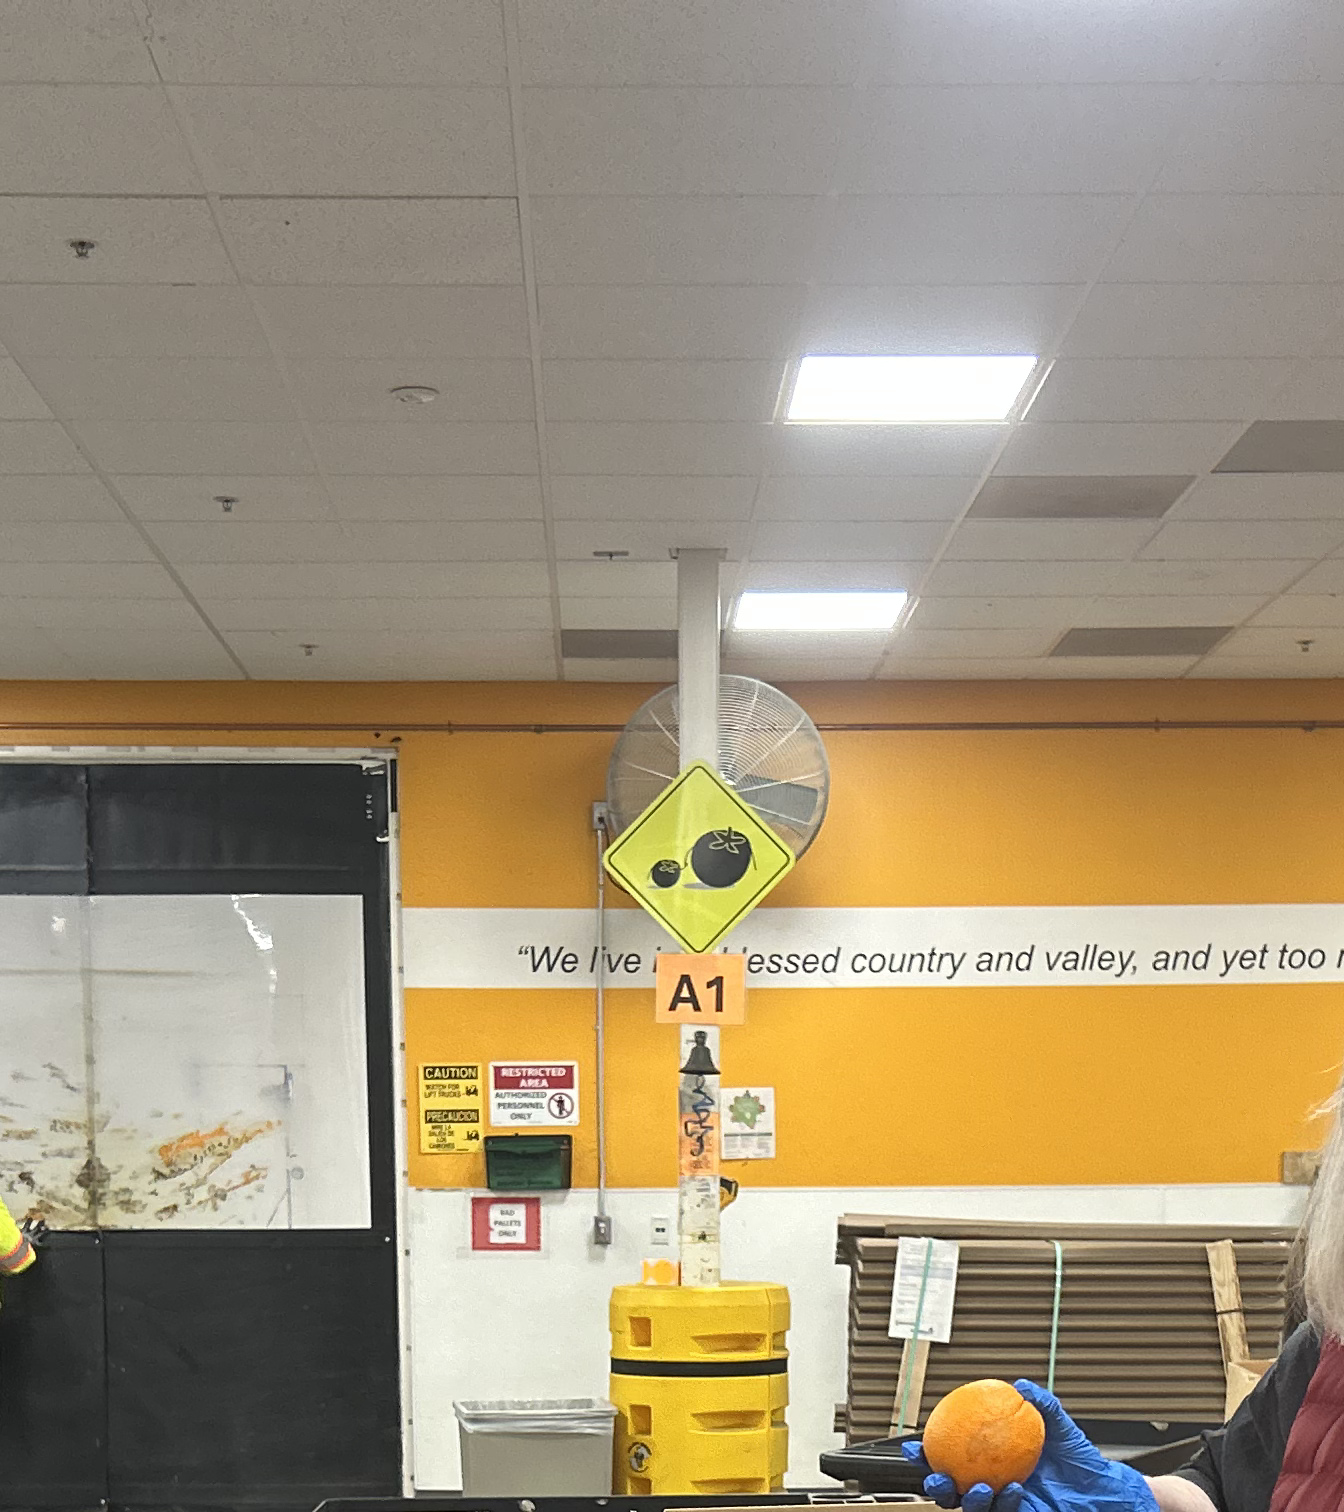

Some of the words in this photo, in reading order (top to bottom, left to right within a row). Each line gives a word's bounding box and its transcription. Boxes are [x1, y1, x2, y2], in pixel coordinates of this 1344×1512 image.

[851, 947, 967, 980] country
[976, 944, 1035, 972] and
[1045, 943, 1137, 978] valley,
[1152, 943, 1212, 971] and
[1219, 943, 1269, 978] yet
[1278, 943, 1326, 970] too
[668, 974, 724, 1013] A1
[425, 1067, 477, 1079] CAUTION
[501, 1067, 567, 1078] RESTRICTED
[519, 1079, 549, 1088] AREA
[494, 1091, 548, 1099] AUTHORIZED
[497, 1102, 545, 1110] PERSONNEL
[510, 1112, 533, 1121] ONLY
[493, 1219, 522, 1227] PALLETS
